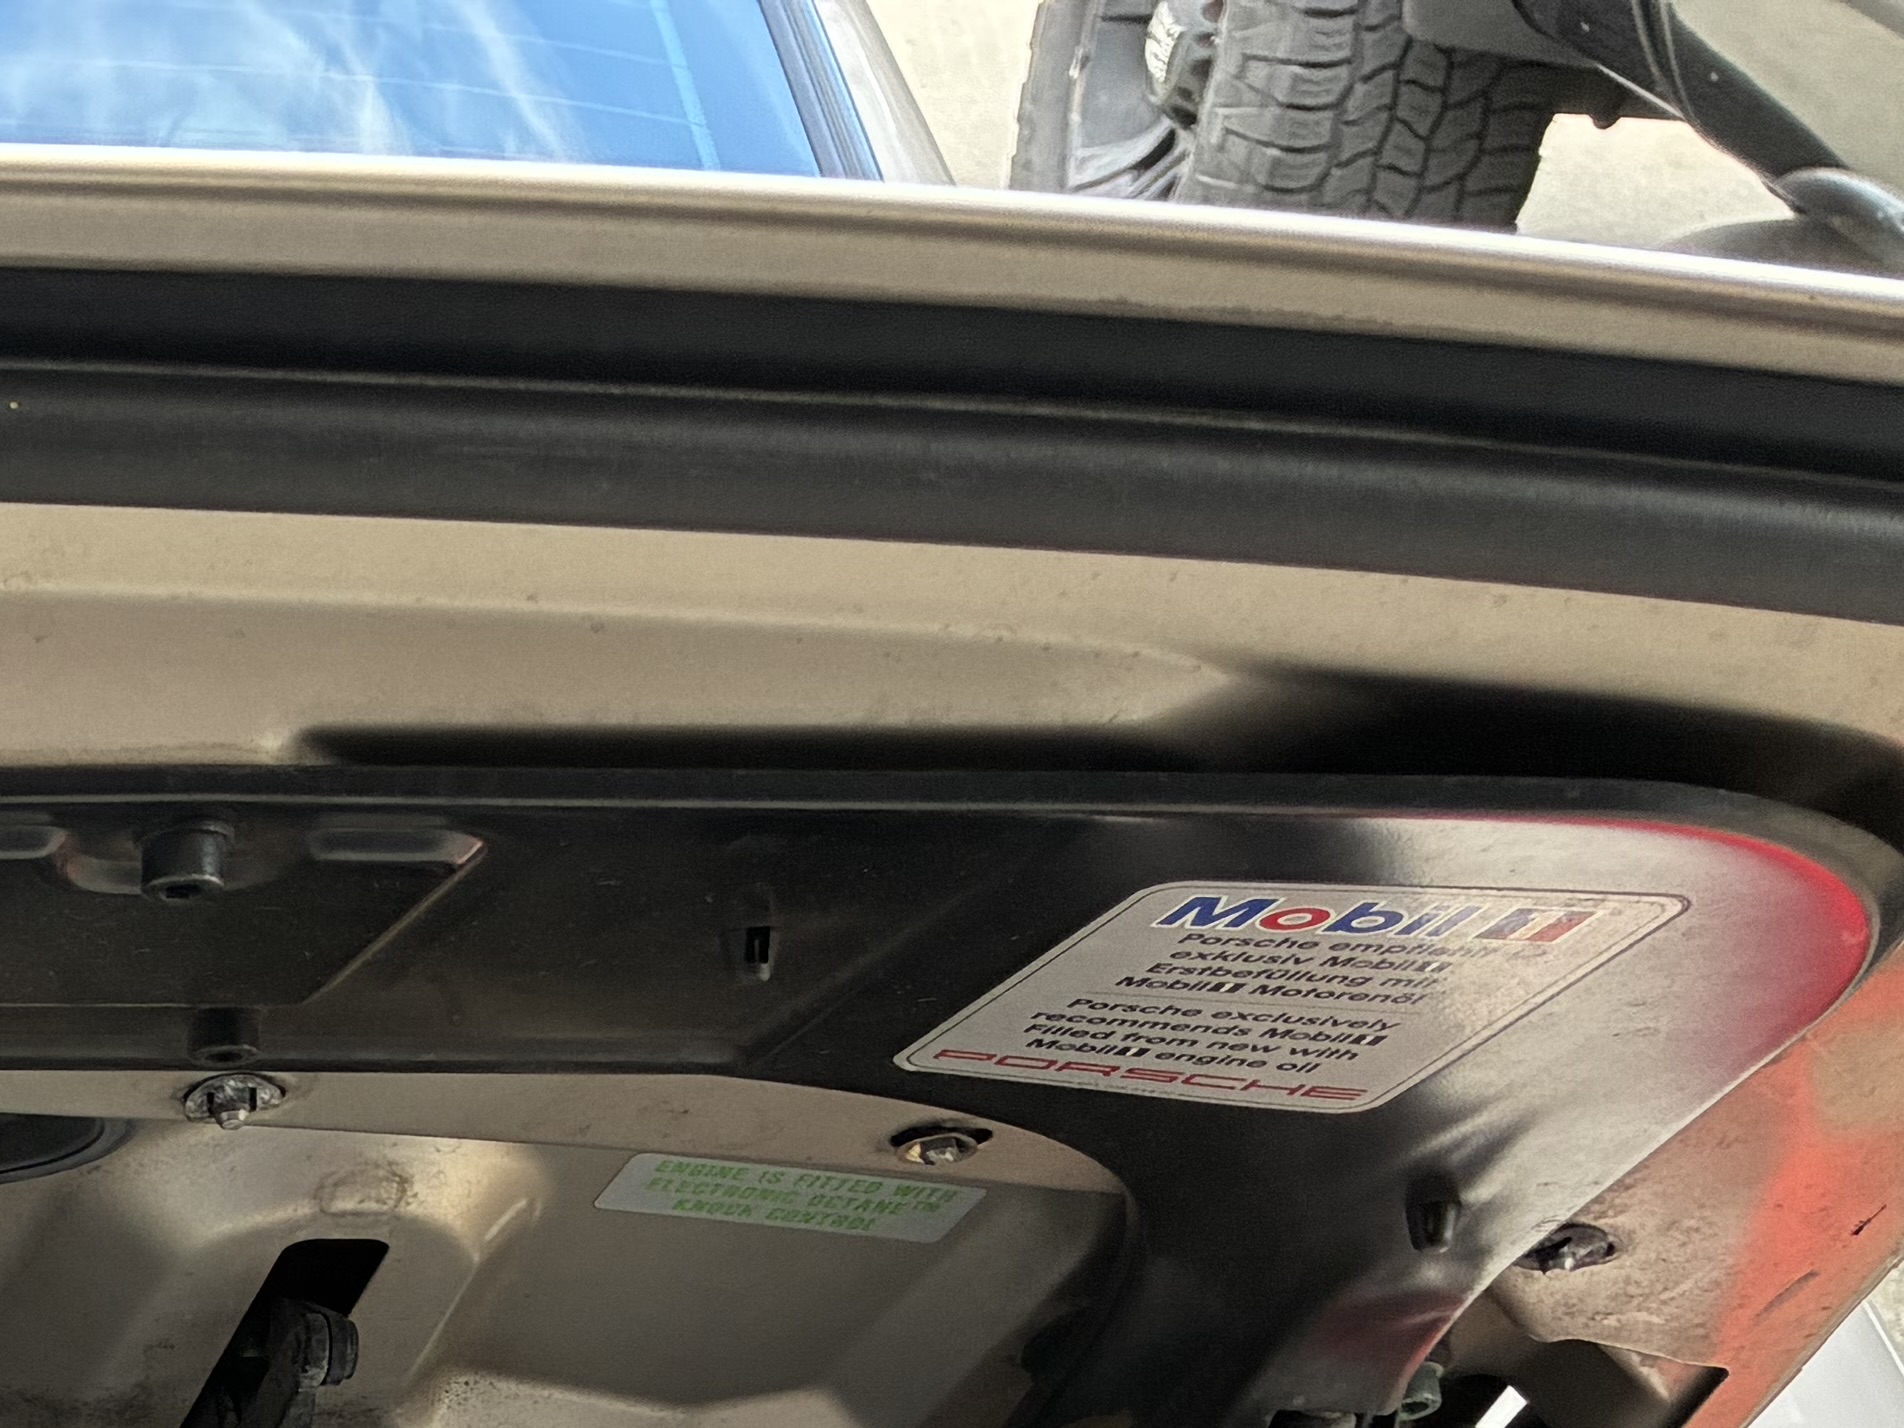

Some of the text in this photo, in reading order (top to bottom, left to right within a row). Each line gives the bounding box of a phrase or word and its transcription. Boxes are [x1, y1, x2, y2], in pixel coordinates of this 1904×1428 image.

[1151, 895, 1486, 937] Mobil
[1177, 933, 1323, 949] Porsche
[1169, 950, 1320, 965] exklusiv
[1145, 963, 1374, 987] Erstbefüllung
[1249, 984, 1430, 1004] Motorenöl
[1030, 1011, 1253, 1037] recommends
[1065, 998, 1403, 1030] Porsche exclusively
[1023, 1025, 1359, 1060] Filled from new with
[933, 1048, 1369, 1102] PORSCHE
[1156, 1051, 1268, 1068] engine
[1278, 1061, 1320, 1073] oil
[656, 1160, 750, 1180] ENGINE
[793, 1173, 884, 1193] FITTED
